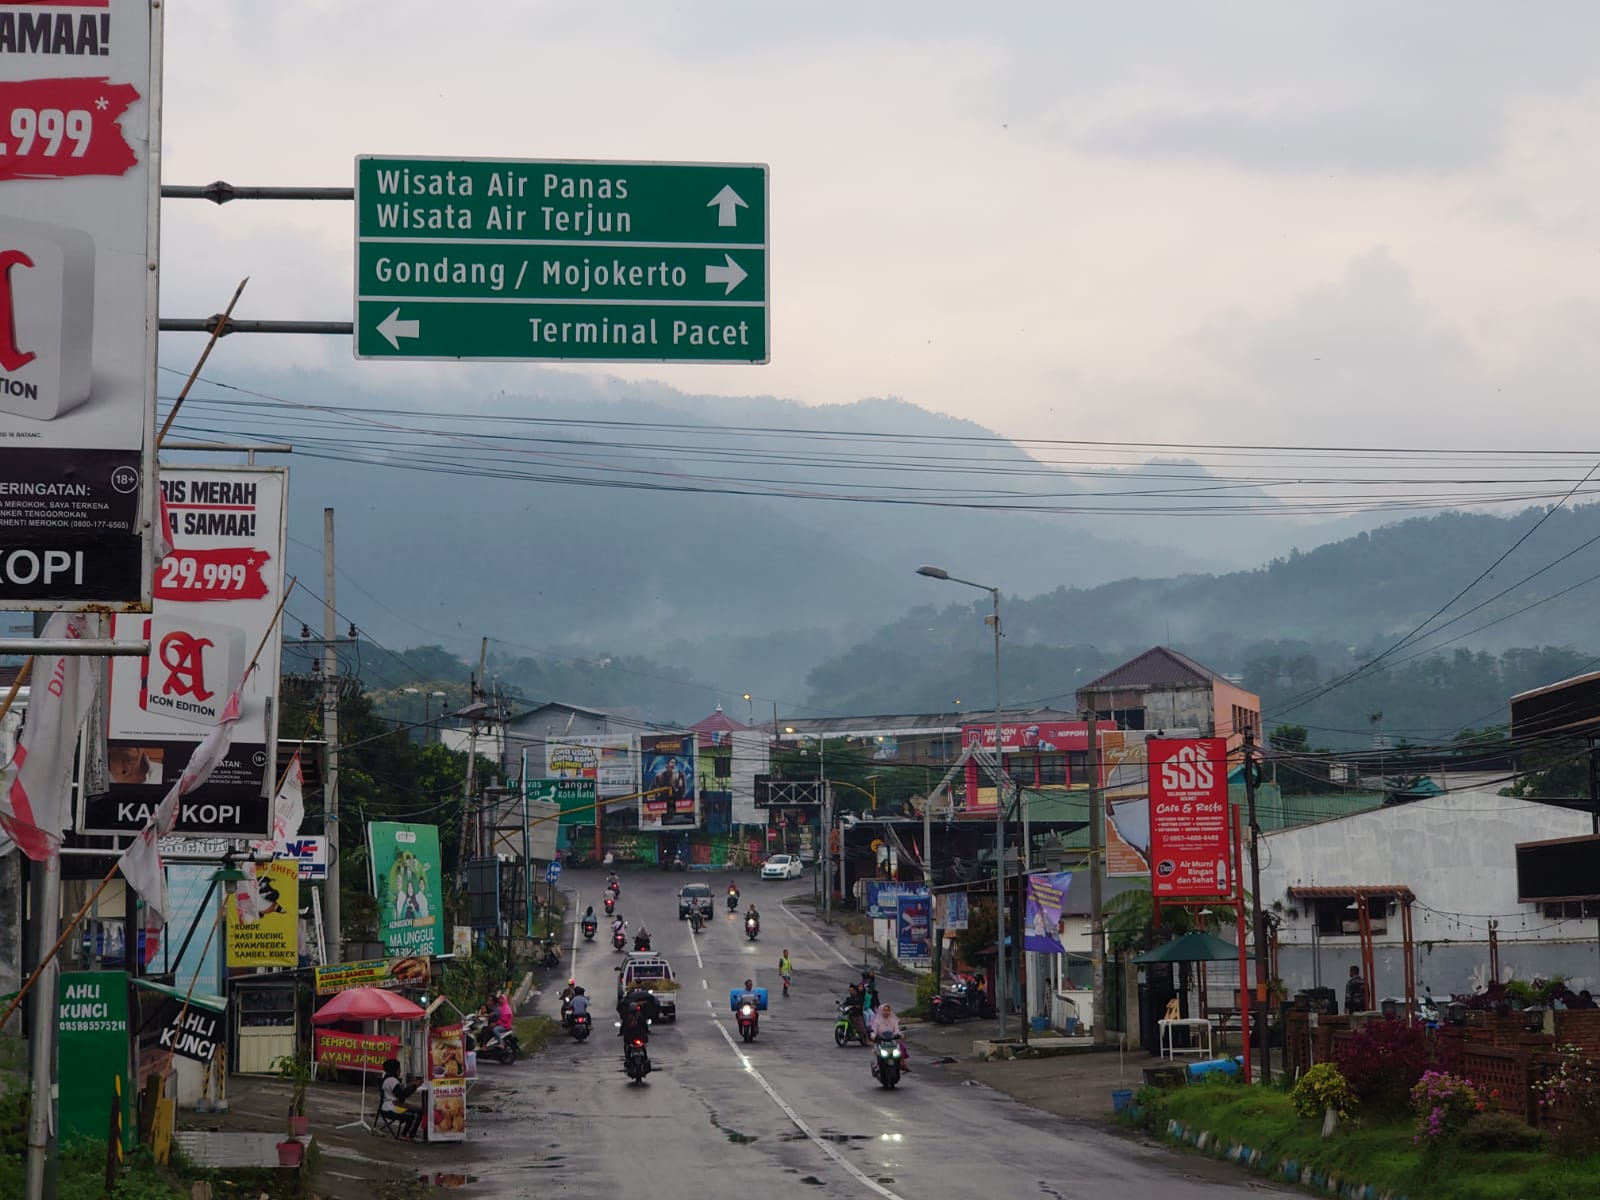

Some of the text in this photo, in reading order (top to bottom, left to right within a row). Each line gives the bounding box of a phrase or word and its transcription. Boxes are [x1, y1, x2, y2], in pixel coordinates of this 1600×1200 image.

[377, 169, 629, 199] Wisata Air Panas
[377, 202, 632, 235] Wisata Air Terjun
[376, 258, 505, 290] Gondang
[543, 260, 687, 292] Mojokerto
[530, 318, 749, 345] Terminal Pacet
[116, 474, 135, 485] 18+
[0, 482, 91, 496] ERINGATAN:
[191, 482, 257, 505] MERAH
[49, 501, 70, 509] SAYA
[72, 502, 110, 510] TERKENA
[29, 519, 69, 528] MEROKOK
[184, 513, 256, 537] SAMAA!
[0, 550, 84, 584] OPI
[149, 694, 216, 717] ICON EDITION
[558, 781, 593, 791] Cangar
[558, 790, 595, 799] Kota Batu
[181, 804, 241, 824] KOPI
[1156, 801, 1223, 814] Cafe & Resto
[1180, 859, 1214, 868] Air Murni
[1177, 876, 1214, 884] dan Sehat
[1187, 868, 1214, 877] Ringan
[66, 984, 100, 999] AHLI
[60, 1003, 108, 1019] KUNCI
[172, 1010, 216, 1037] AHLI
[159, 1027, 216, 1060] KUNCI
[320, 1036, 357, 1049] SEMPOL
[320, 1051, 351, 1062] AYAM
